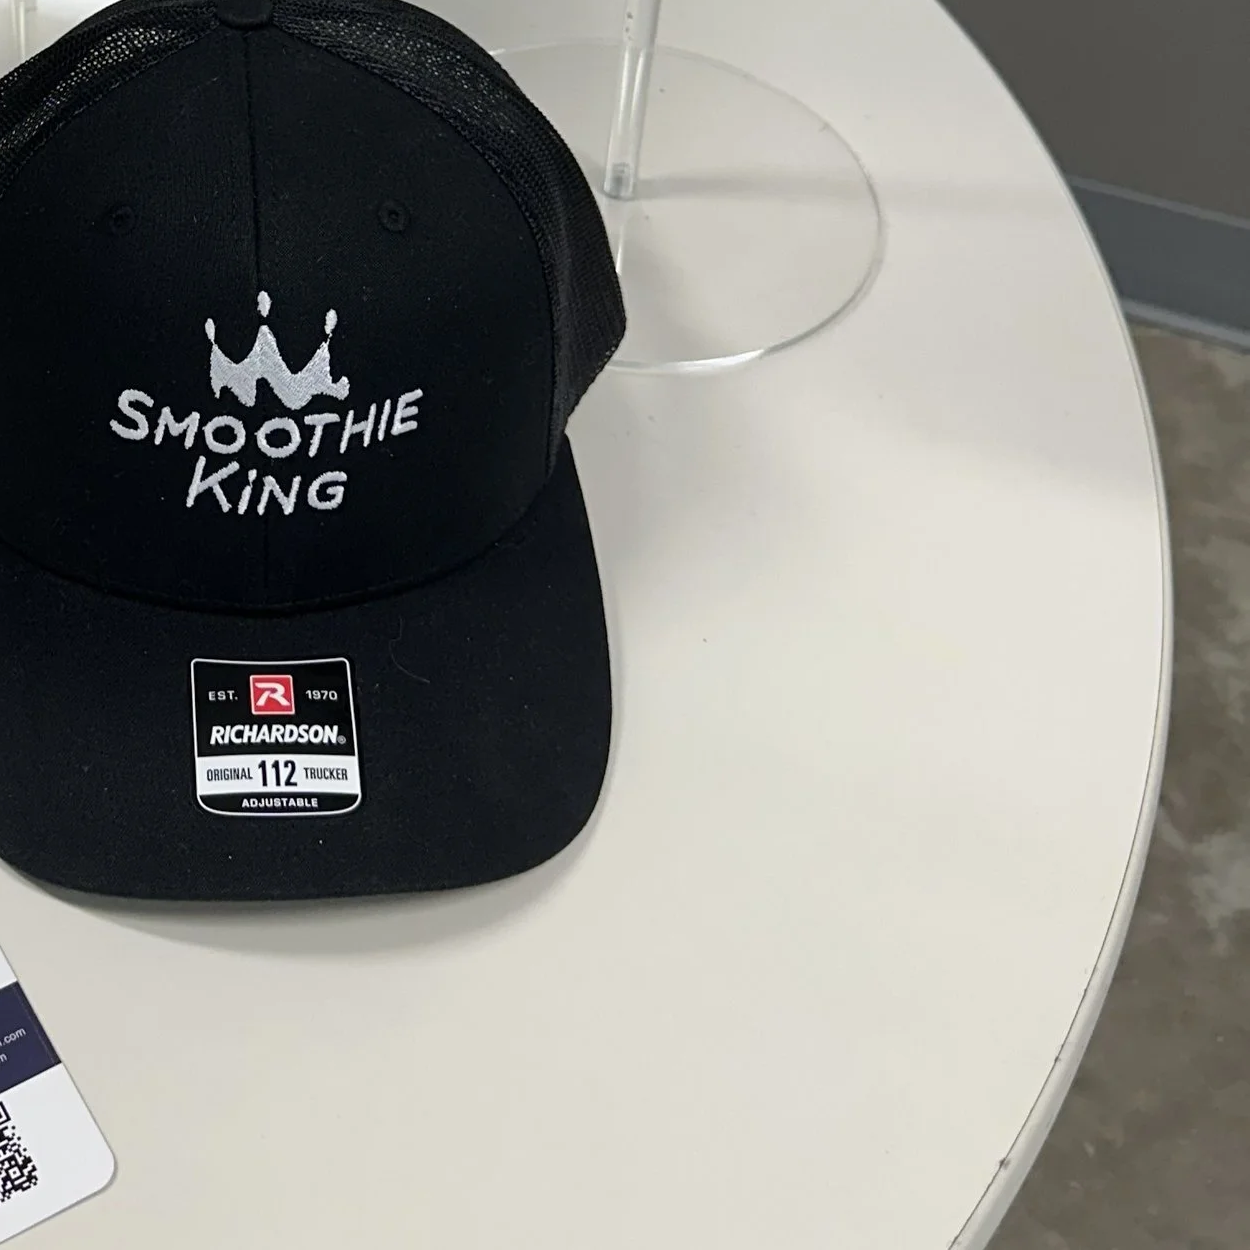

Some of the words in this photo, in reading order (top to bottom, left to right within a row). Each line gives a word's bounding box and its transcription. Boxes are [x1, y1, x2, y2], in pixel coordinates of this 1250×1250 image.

[110, 389, 423, 458] SMOOTHIE
[208, 690, 238, 701] EST.
[306, 690, 338, 701] 1970
[206, 767, 253, 782] ORIGINAL
[258, 759, 298, 787] 112
[304, 767, 349, 781] TRUCKER
[241, 797, 319, 808] ADJUSTABLE
